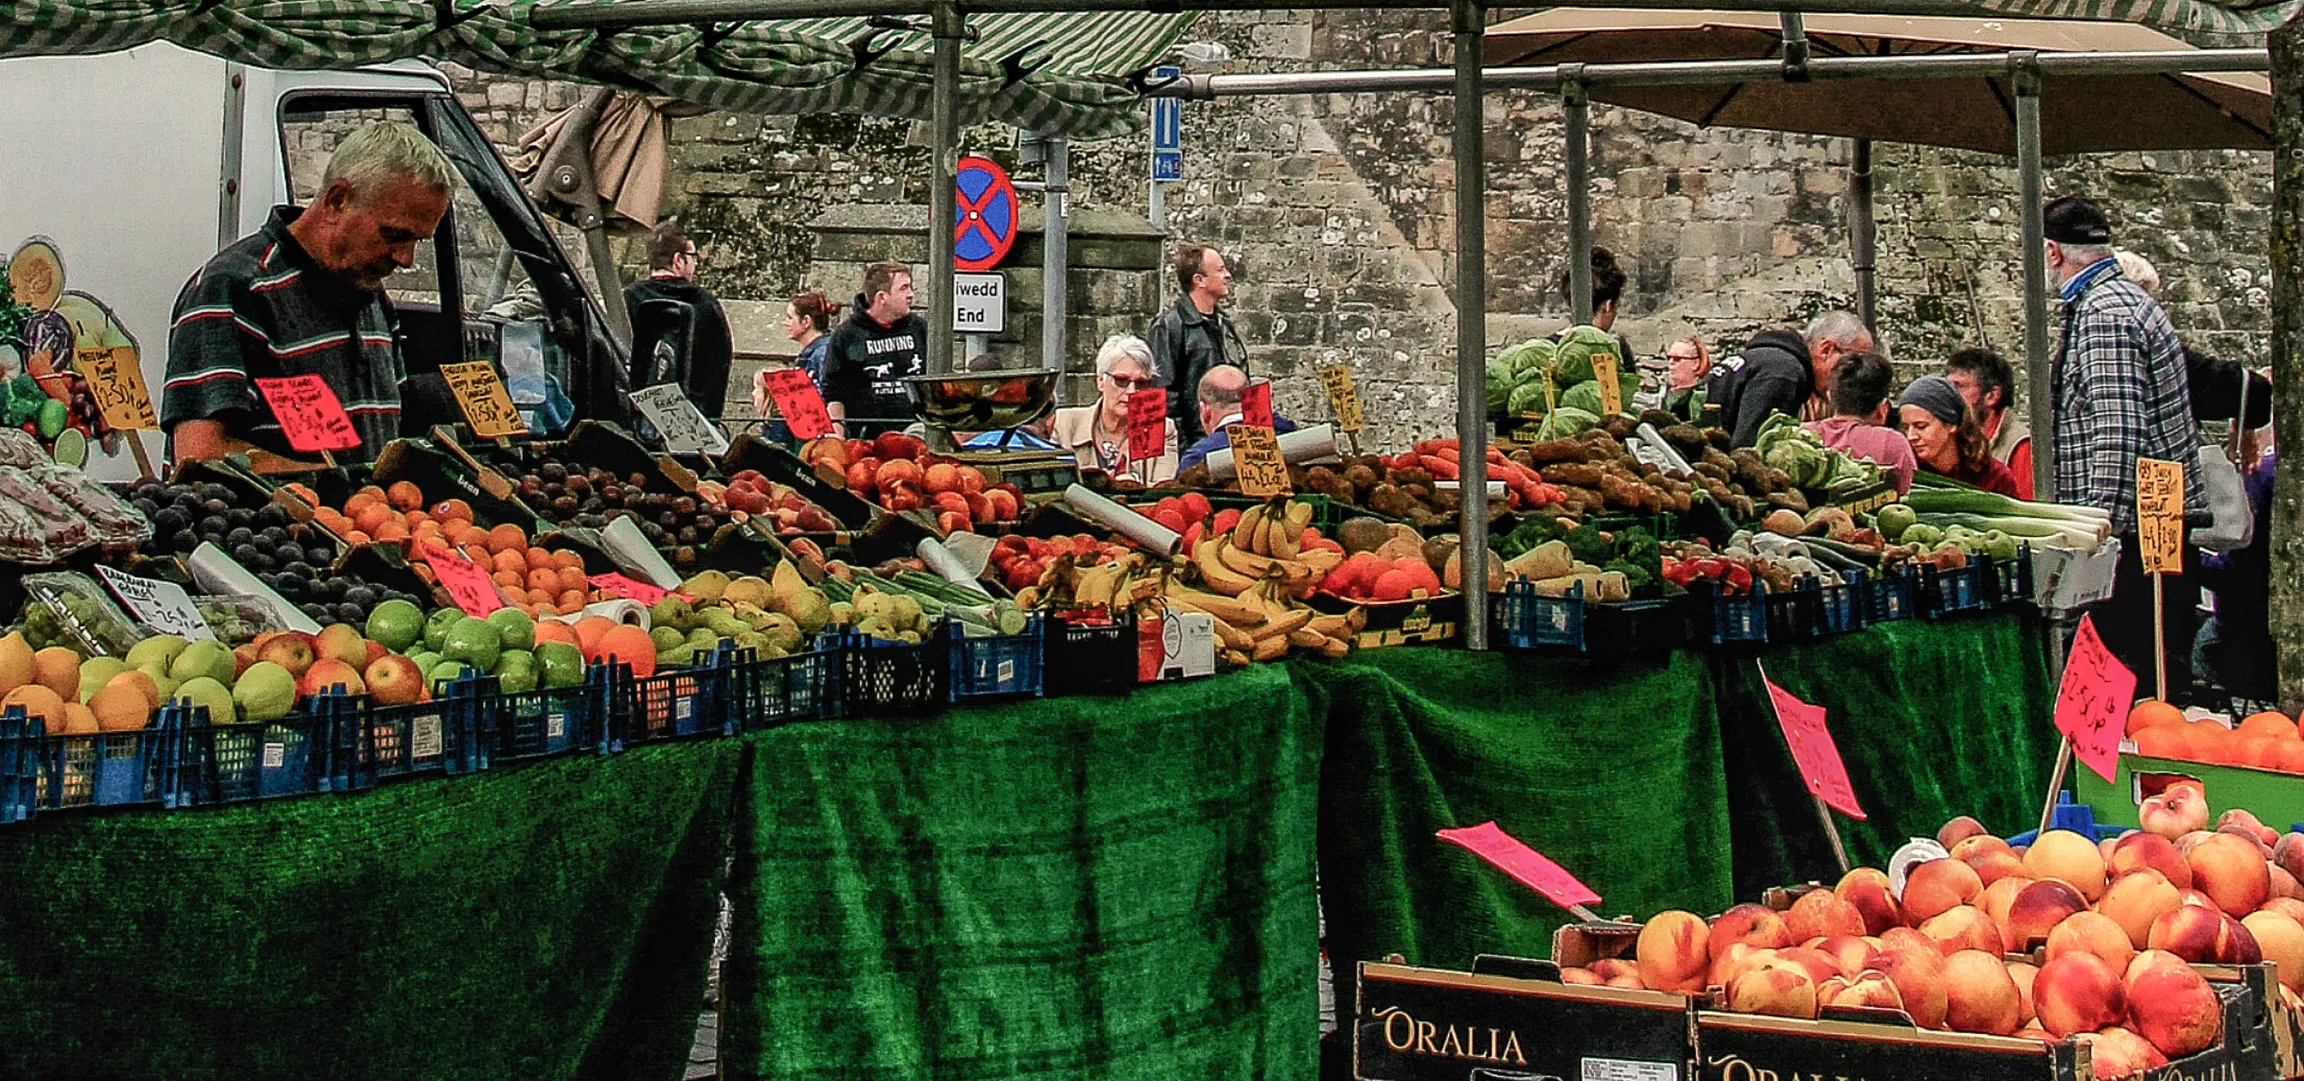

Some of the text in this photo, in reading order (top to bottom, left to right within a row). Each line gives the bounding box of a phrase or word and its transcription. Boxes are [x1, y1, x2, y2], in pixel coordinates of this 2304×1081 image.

[955, 281, 998, 297] iwedd
[957, 307, 985, 322] End
[865, 334, 915, 355] RUNNING
[1372, 1006, 1529, 1067] ORALIA
